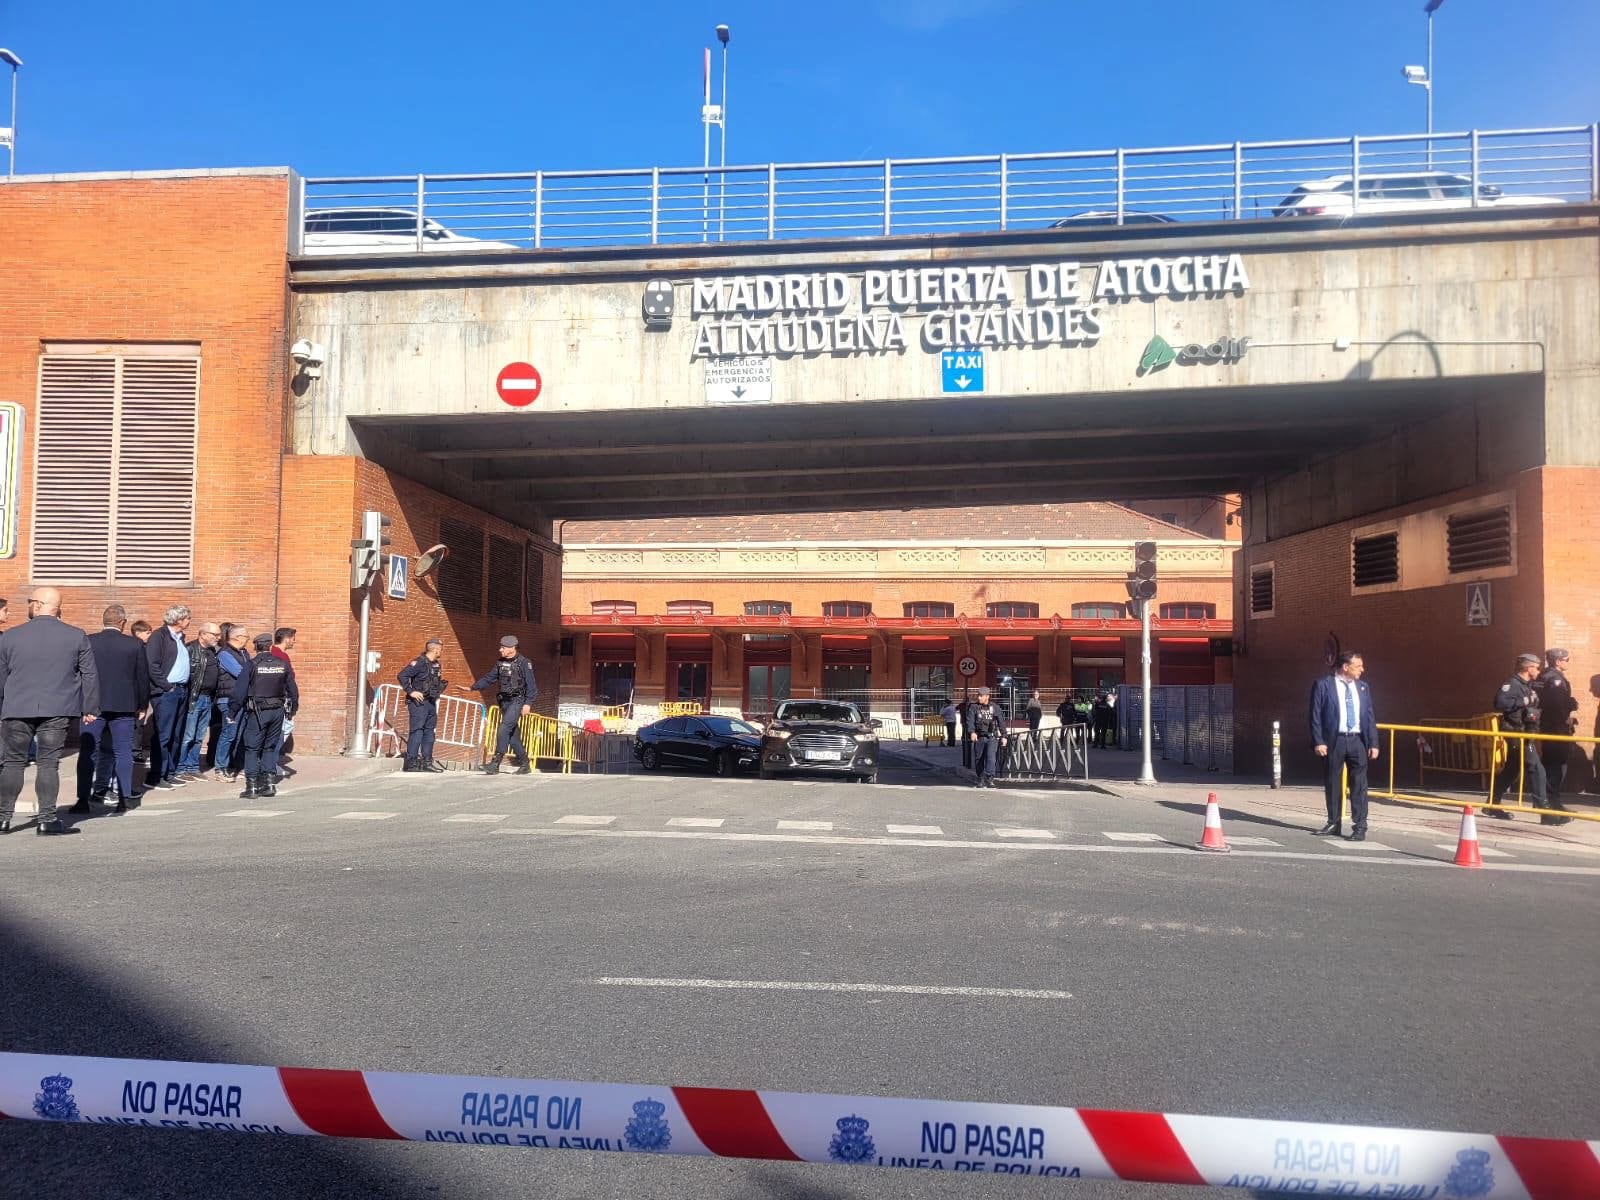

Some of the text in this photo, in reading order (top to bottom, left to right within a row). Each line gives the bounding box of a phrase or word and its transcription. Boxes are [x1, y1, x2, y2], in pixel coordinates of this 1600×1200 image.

[692, 253, 1251, 313] MADRID PUERTA DE ATOCHA
[692, 303, 1105, 356] ALMUDENA GRANDES
[1182, 335, 1249, 358] adif
[705, 368, 764, 377] EMERGENCIA
[943, 355, 982, 369] TAXI
[706, 376, 771, 385] AUTORIZADOS
[961, 661, 975, 671] 20
[122, 1079, 242, 1118] NO PASAR
[921, 1121, 1044, 1160] NO PASAR
